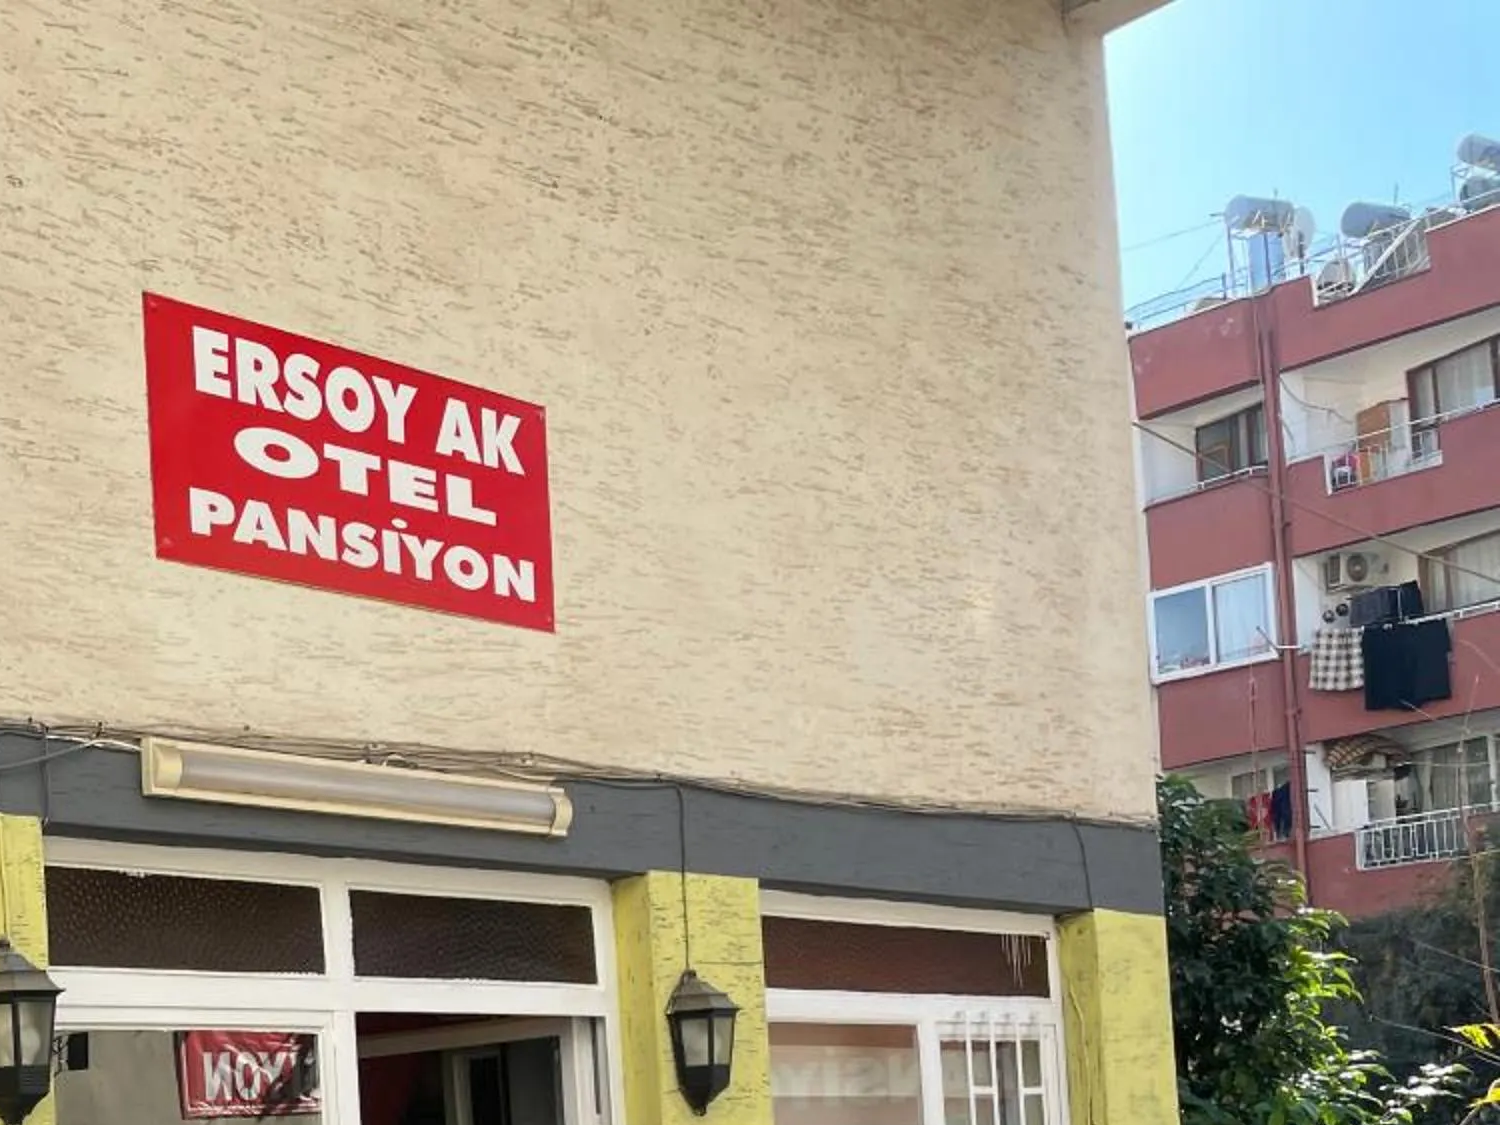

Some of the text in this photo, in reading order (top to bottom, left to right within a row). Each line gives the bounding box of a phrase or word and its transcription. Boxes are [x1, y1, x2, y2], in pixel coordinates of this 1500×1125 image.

[192, 325, 525, 476] ERSOY AK
[233, 427, 497, 527] OTEL
[189, 486, 536, 603] PANSİYON
